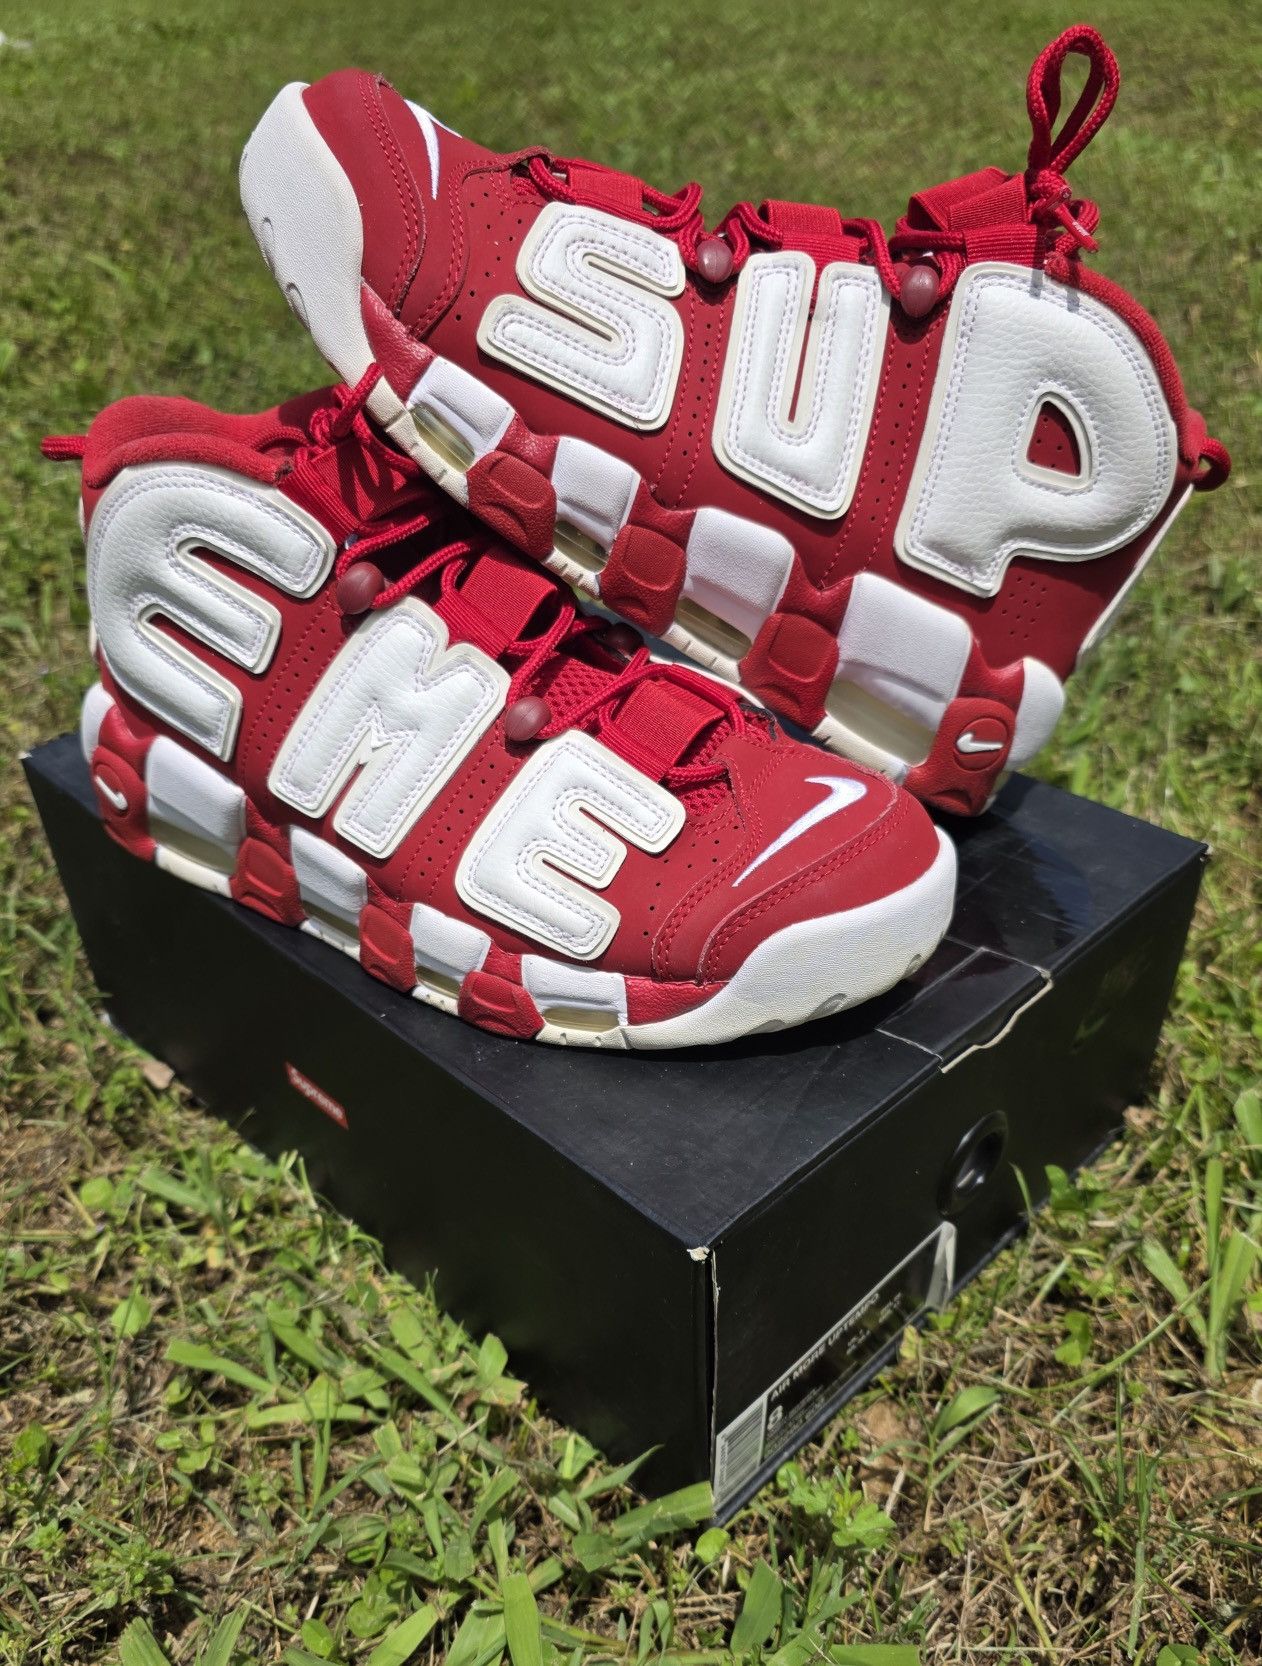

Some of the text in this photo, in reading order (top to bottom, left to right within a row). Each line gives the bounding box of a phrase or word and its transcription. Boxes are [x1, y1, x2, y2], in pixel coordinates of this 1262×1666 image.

[476, 201, 1178, 597] SUP
[88, 460, 686, 961] EME
[770, 1376, 791, 1401] AIR
[793, 1344, 827, 1379] MORE
